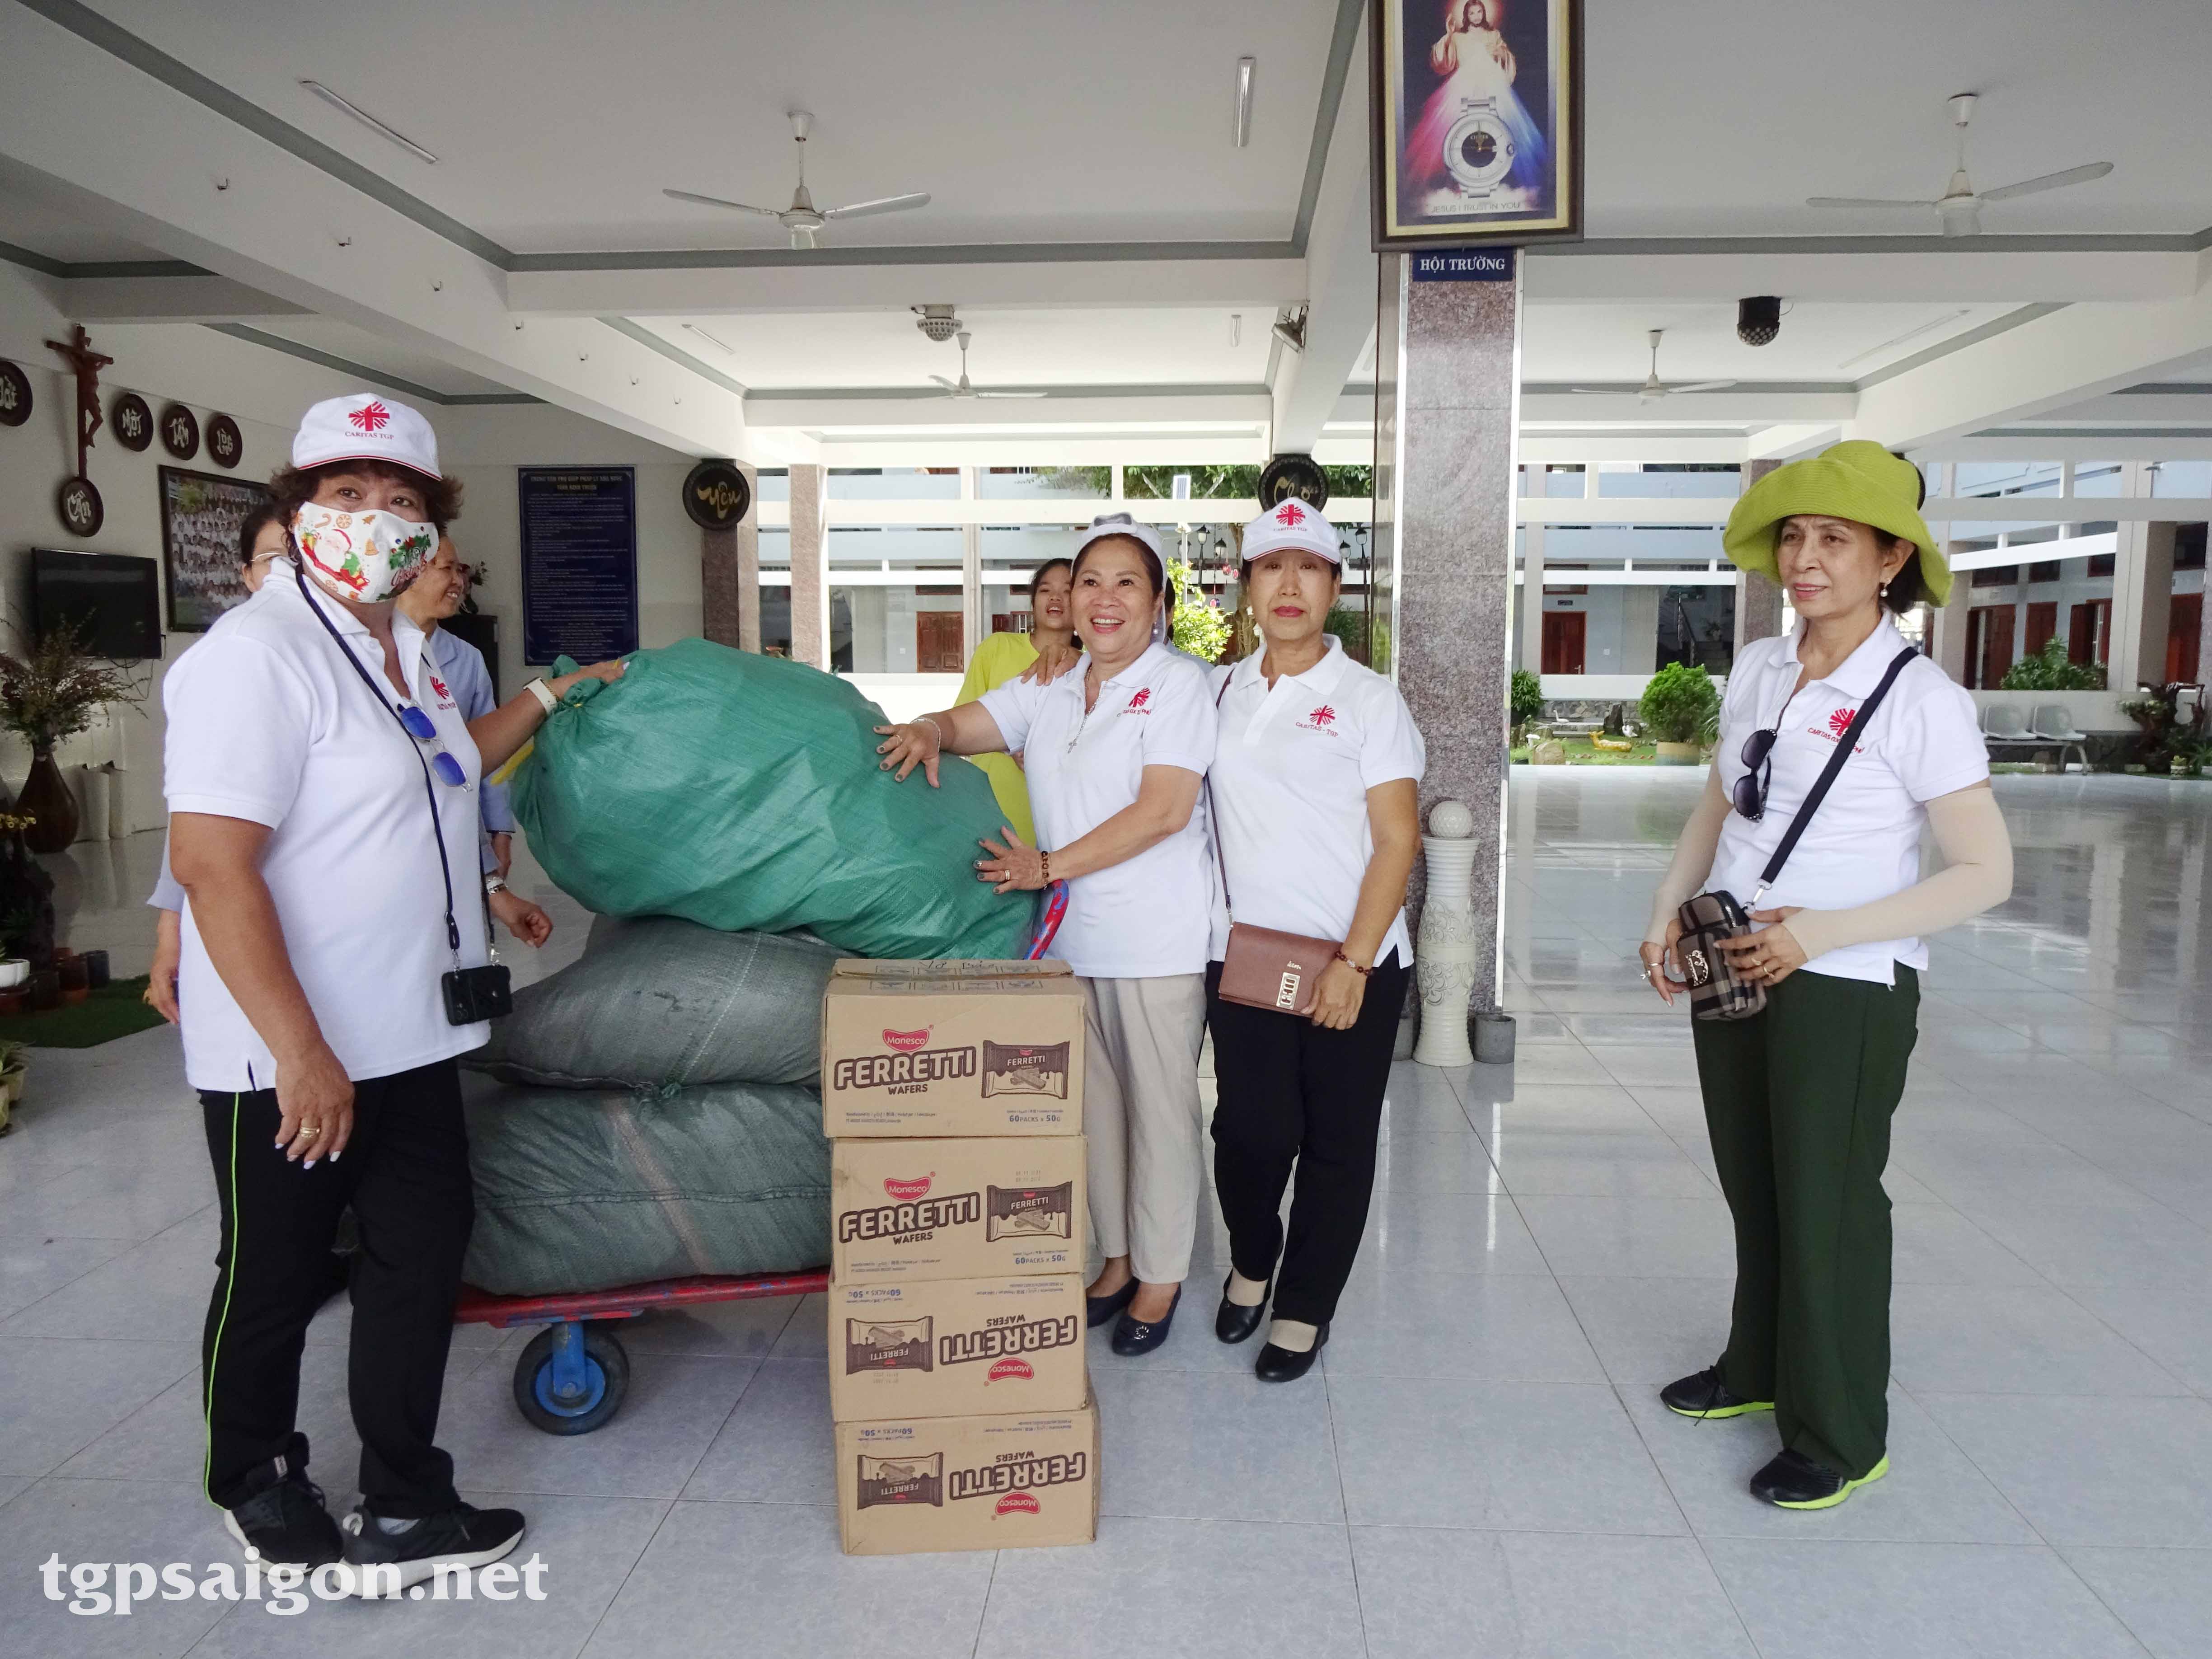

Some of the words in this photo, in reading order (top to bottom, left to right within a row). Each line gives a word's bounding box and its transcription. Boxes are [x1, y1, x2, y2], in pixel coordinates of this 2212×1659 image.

[1431, 205, 1457, 213] JESUS
[1464, 203, 1488, 211] TRUST
[1420, 256, 1446, 273] HỘI
[1449, 255, 1505, 271] TRƯỜNG
[345, 431, 377, 439] CARITAS
[1295, 722, 1322, 731] CARITAS
[1807, 727, 1831, 740] CARITAS
[886, 1036, 927, 1045] Monesco
[1007, 1055, 1045, 1066] FERRETTI
[836, 1048, 975, 1088] FERRETTI
[888, 1084, 928, 1095] WAFERS
[888, 1186, 927, 1194] Monesco
[1011, 1196, 1049, 1209] FERRETTI
[841, 1194, 978, 1242] FERRETTI
[893, 1232, 933, 1245] WAFERS
[986, 1314, 1026, 1327] WAFERS
[941, 1317, 1075, 1364] FERRETTI
[871, 1349, 909, 1362] FERRETTI
[992, 1365, 1030, 1373] Monesco
[996, 1451, 1034, 1463] WAFERS
[951, 1454, 1084, 1498] FERRETTI
[881, 1484, 919, 1495] FERRETTI
